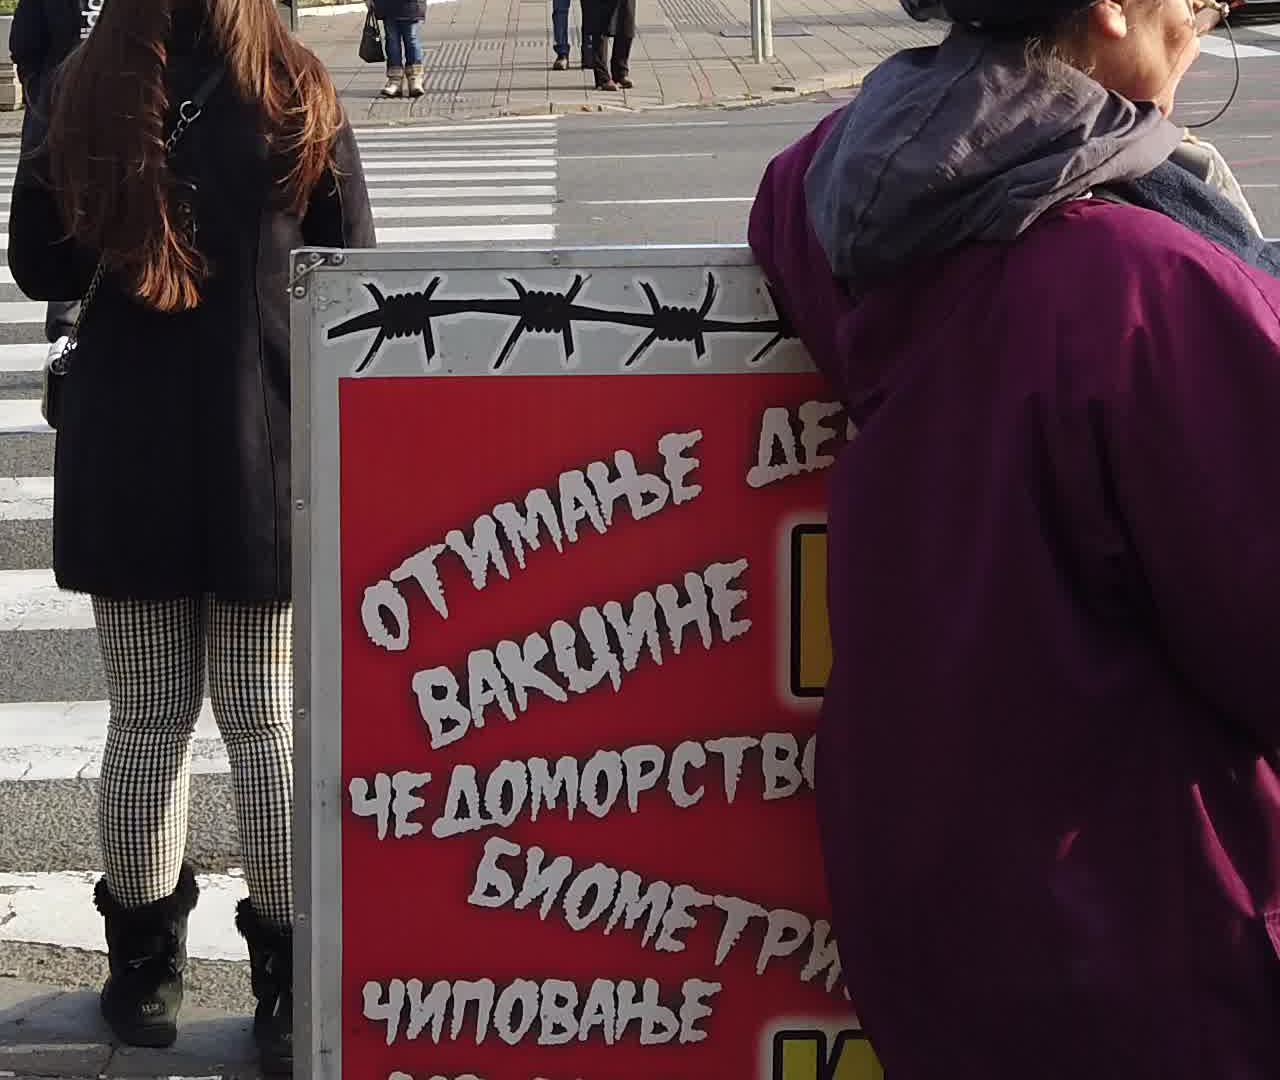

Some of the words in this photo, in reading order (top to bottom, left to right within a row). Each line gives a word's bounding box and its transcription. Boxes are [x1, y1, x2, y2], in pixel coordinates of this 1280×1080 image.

[361, 430, 703, 650] ОТИМАЊЕ
[746, 401, 858, 489] ДЕ
[412, 559, 752, 749] ВАКЦИНЕ
[468, 836, 852, 1002] БИОМЕТРИ
[362, 978, 721, 1046] ЧИПОВАЊЕ
